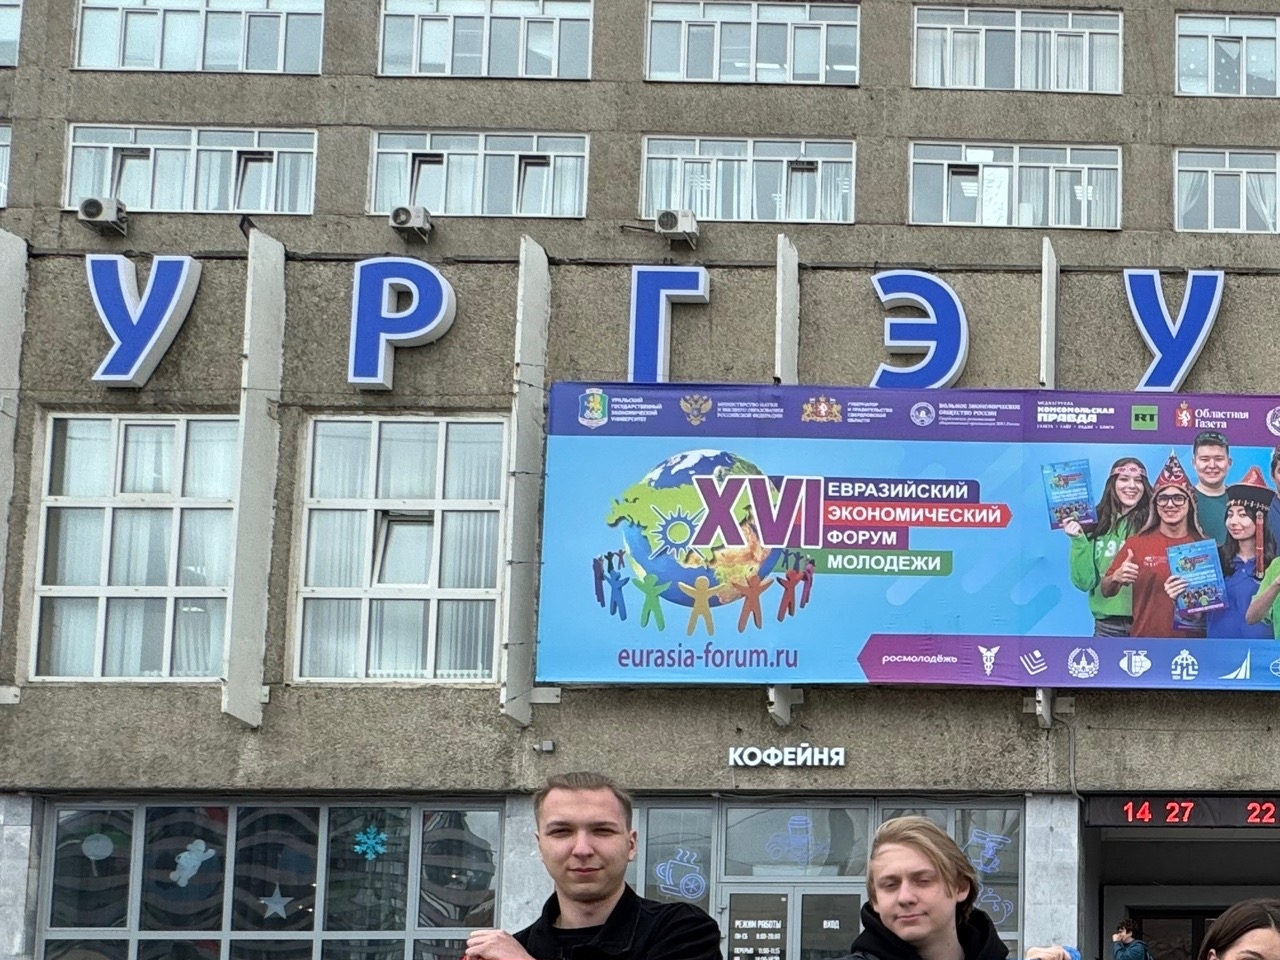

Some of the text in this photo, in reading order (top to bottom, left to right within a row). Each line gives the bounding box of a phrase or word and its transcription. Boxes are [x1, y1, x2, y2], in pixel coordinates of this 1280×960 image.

[1037, 406, 1115, 414] КОМСОМОЛЬСКАЯ
[1037, 413, 1097, 424] ПРАВДА
[1134, 412, 1158, 423] RT
[1194, 409, 1249, 420] Областная
[1195, 418, 1227, 429] Газета
[827, 480, 969, 500] ЕВРАЗИЙСКИЙ
[692, 474, 825, 549] XVI
[827, 504, 1002, 524] ЭКОНОМИЧЕСКИЙ
[826, 529, 898, 547] ФОРУМ
[827, 553, 942, 573] МОЛОДЕЖИ
[617, 641, 799, 669] eurasia-forum.ru
[881, 653, 958, 665] росмолодёжь
[728, 742, 845, 767] КОФЕЙНЯ
[1122, 801, 1152, 823] 14
[1165, 802, 1194, 823] 27
